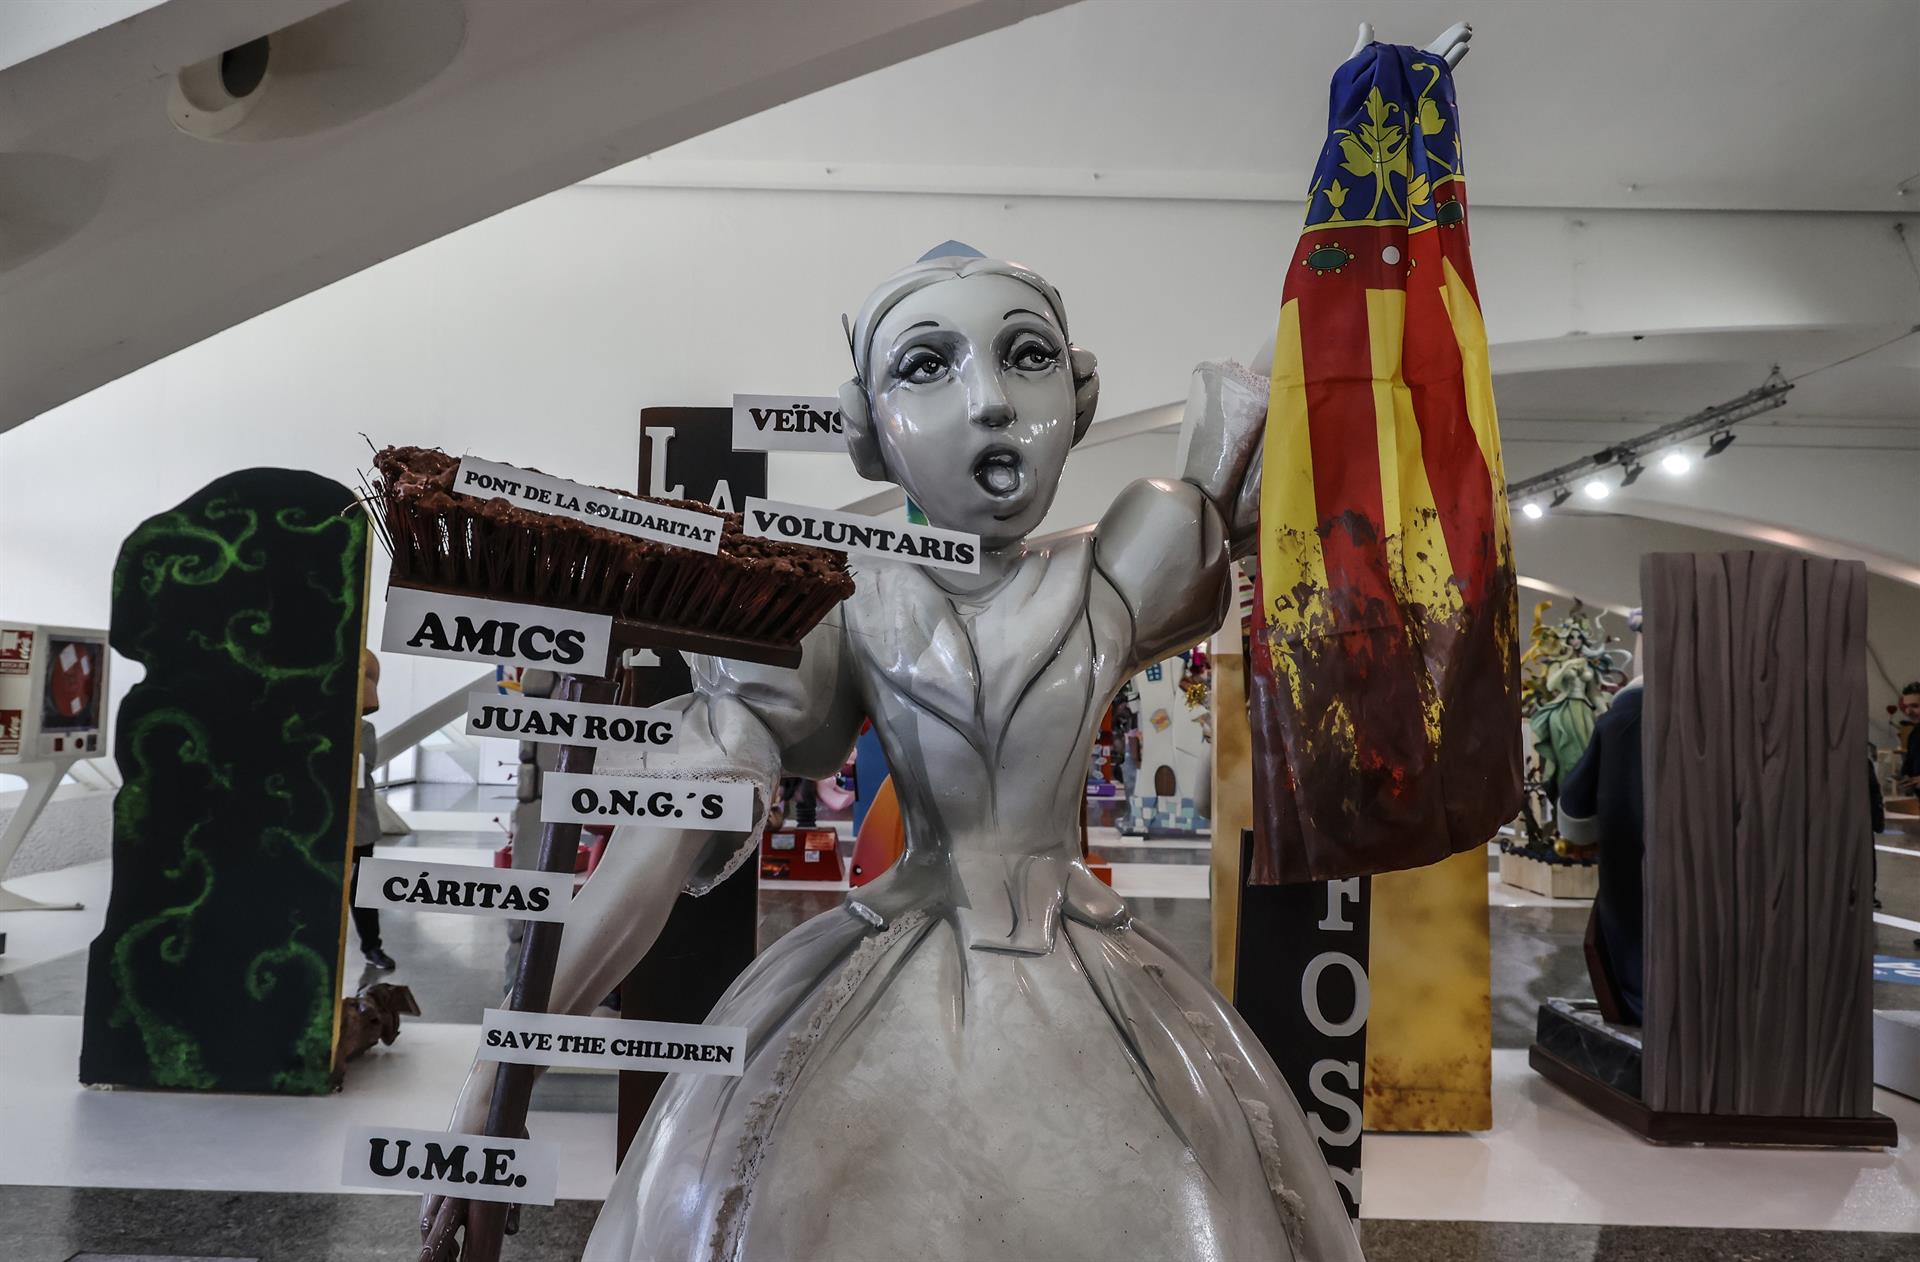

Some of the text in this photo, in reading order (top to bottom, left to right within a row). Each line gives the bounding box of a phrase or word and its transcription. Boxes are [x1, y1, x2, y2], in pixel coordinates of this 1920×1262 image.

[464, 470, 716, 543] PONT DE LA SOLIDARITAT
[752, 510, 976, 565] VOLUNTARIS
[406, 611, 587, 665] AMICS
[471, 705, 674, 746] JUAN ROIG
[382, 871, 550, 912] CÁRITAS
[486, 1029, 735, 1064] SAVE THE CHILDREN
[369, 1137, 527, 1188] U.M.E.
